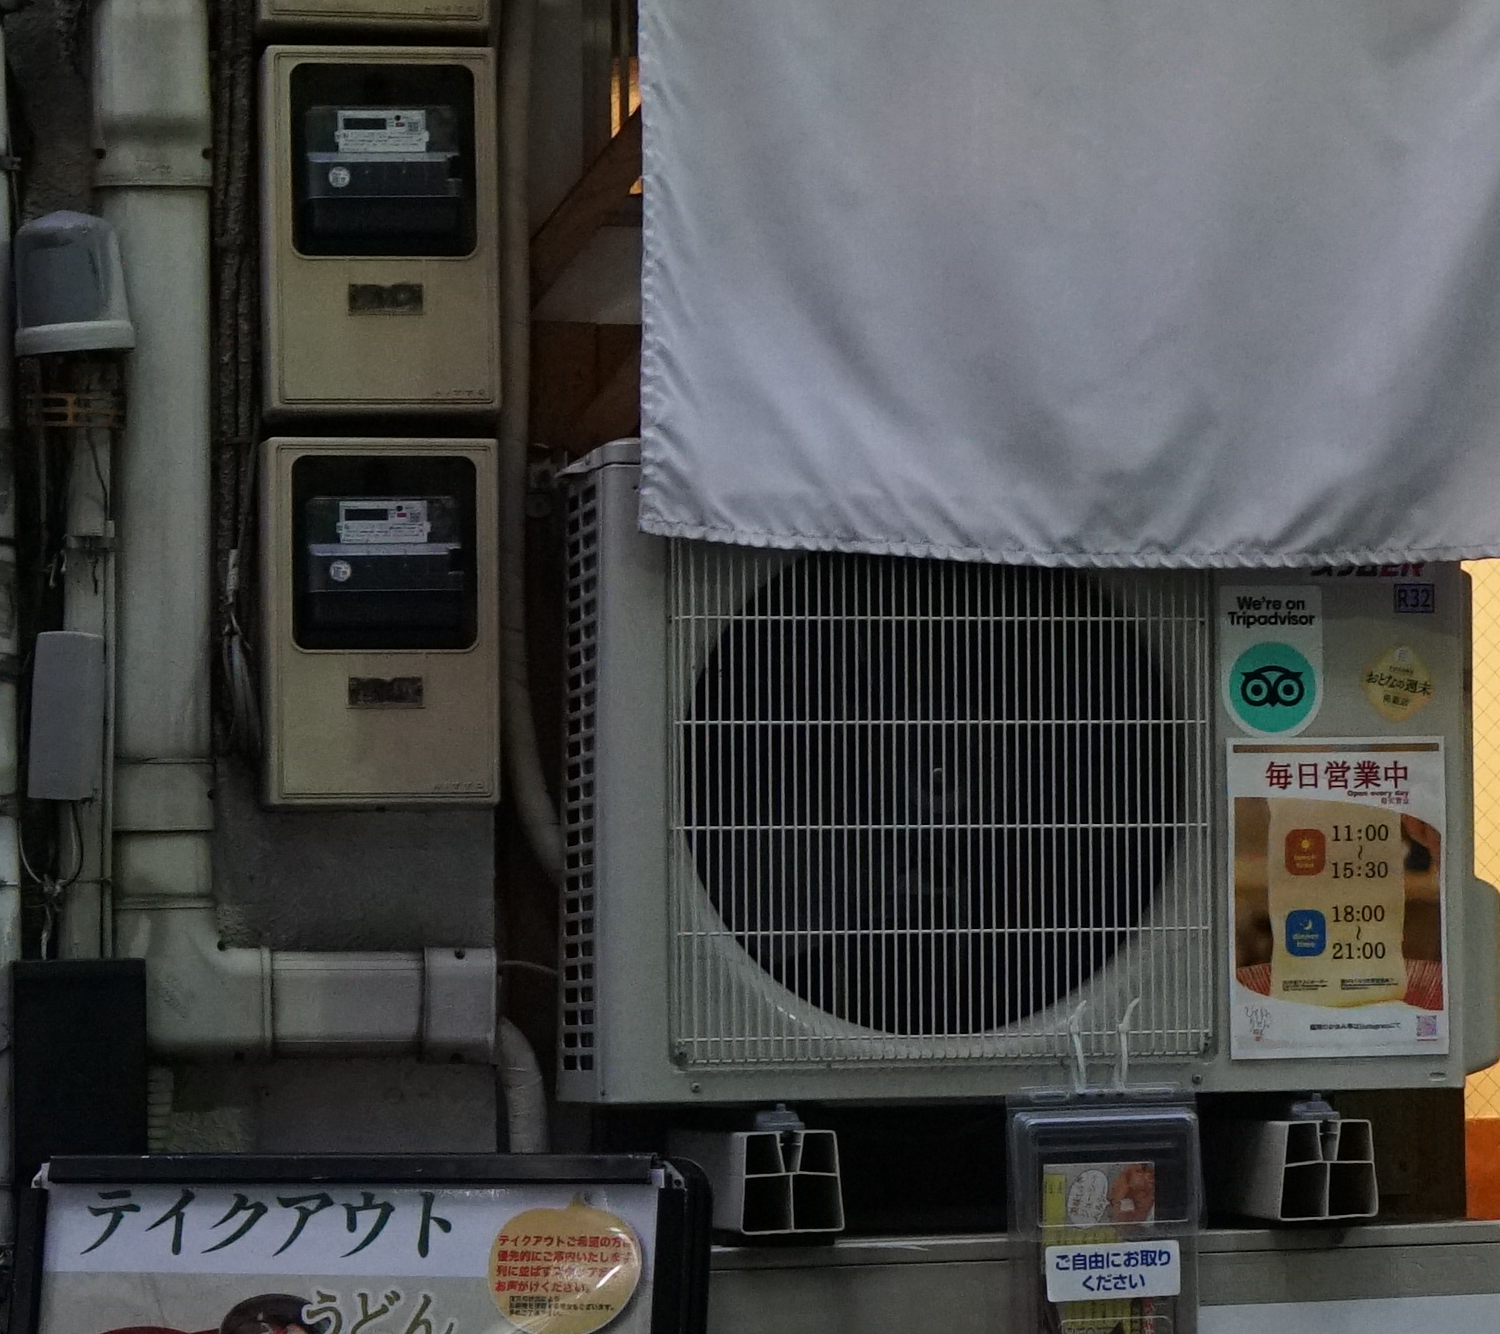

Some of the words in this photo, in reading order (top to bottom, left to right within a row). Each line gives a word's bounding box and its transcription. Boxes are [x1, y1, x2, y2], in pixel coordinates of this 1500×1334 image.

[1286, 598, 1305, 611] on
[1397, 588, 1431, 609] R32
[1228, 611, 1316, 629] Tripadvisor
[1265, 759, 1409, 790] 毎日営業中
[1395, 790, 1410, 799] day
[1331, 824, 1389, 843] 11:00
[1331, 861, 1389, 879] 15:30
[1331, 905, 1386, 923] 18:00
[1331, 941, 1387, 960] 21:00
[79, 1189, 454, 1259] テイクアウト
[1055, 1248, 1172, 1271] ご自由にお取り
[1081, 1273, 1146, 1292] ください
